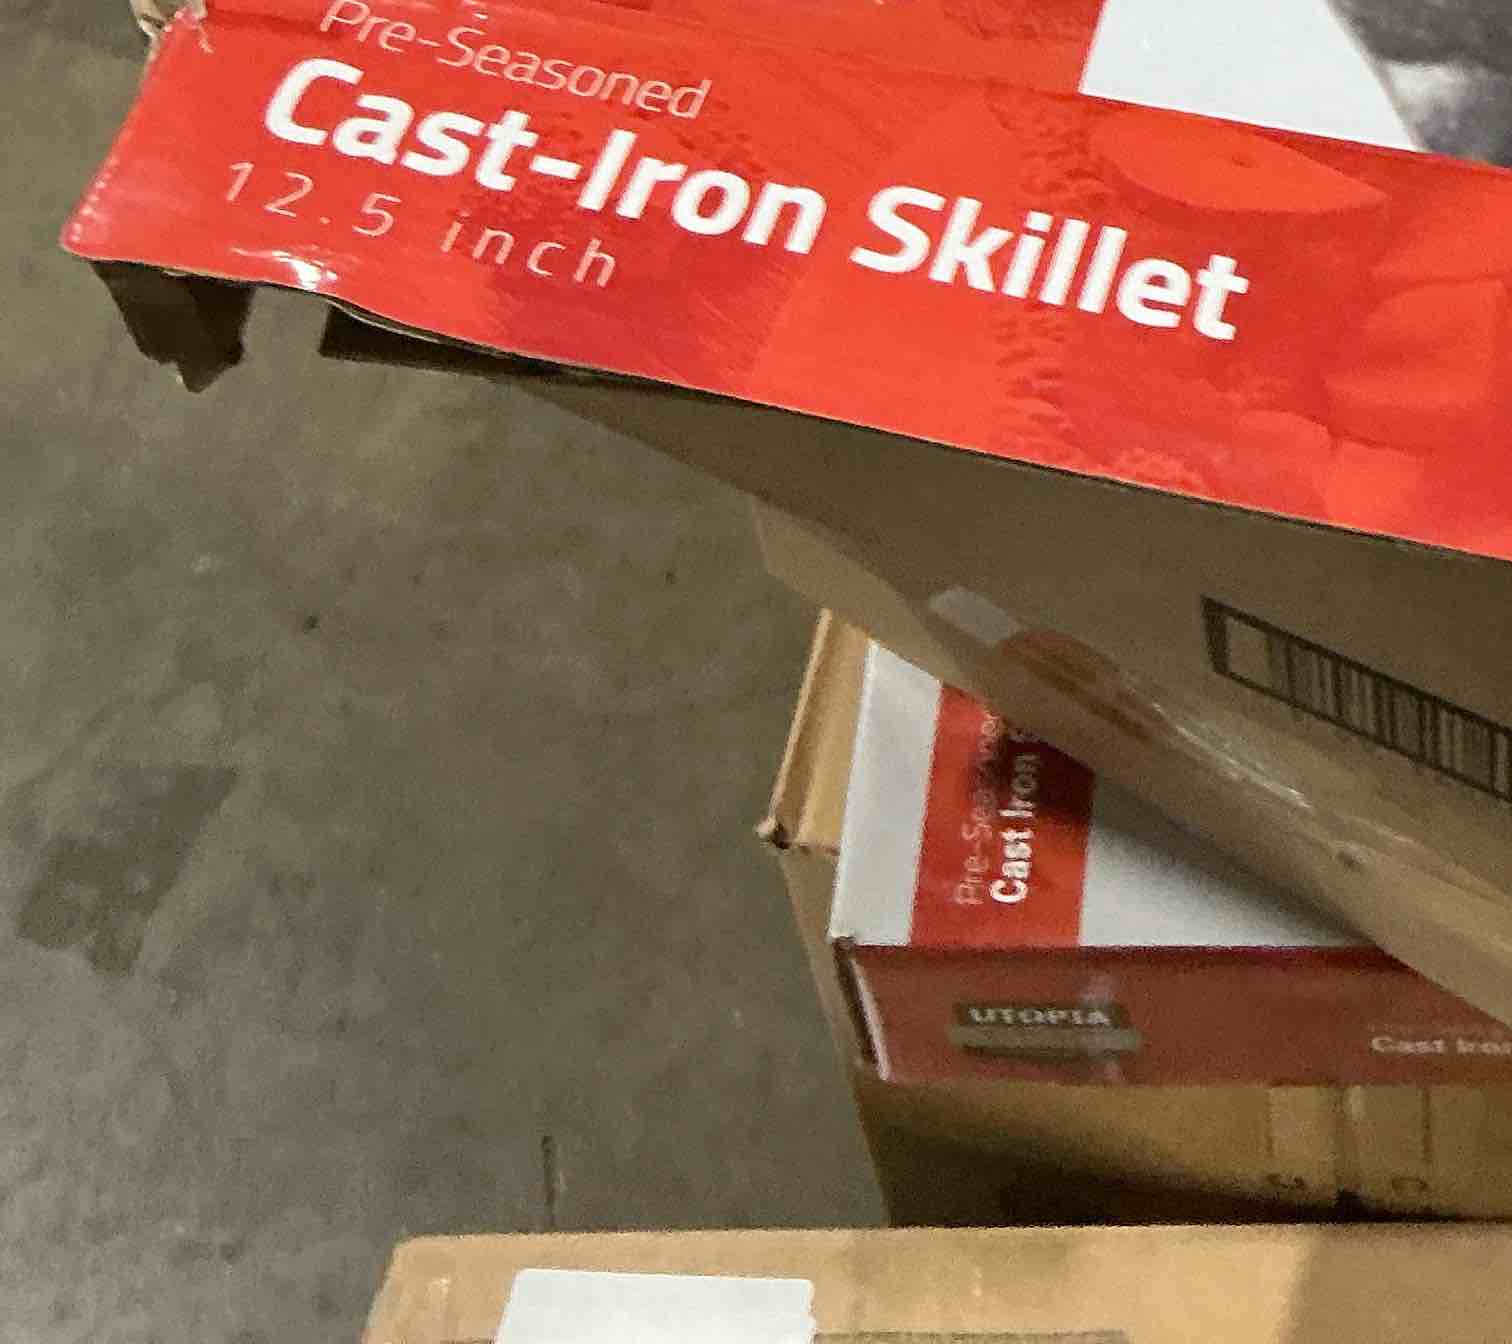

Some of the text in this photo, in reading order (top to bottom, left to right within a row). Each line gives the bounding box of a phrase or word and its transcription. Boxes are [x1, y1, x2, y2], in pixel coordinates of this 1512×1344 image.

[224, 161, 618, 288] 12.5 inch
[264, 58, 1250, 341] Cast-Iron Skillet
[989, 753, 1040, 905] Cast Iron
[1370, 1035, 1447, 1056] Cast
